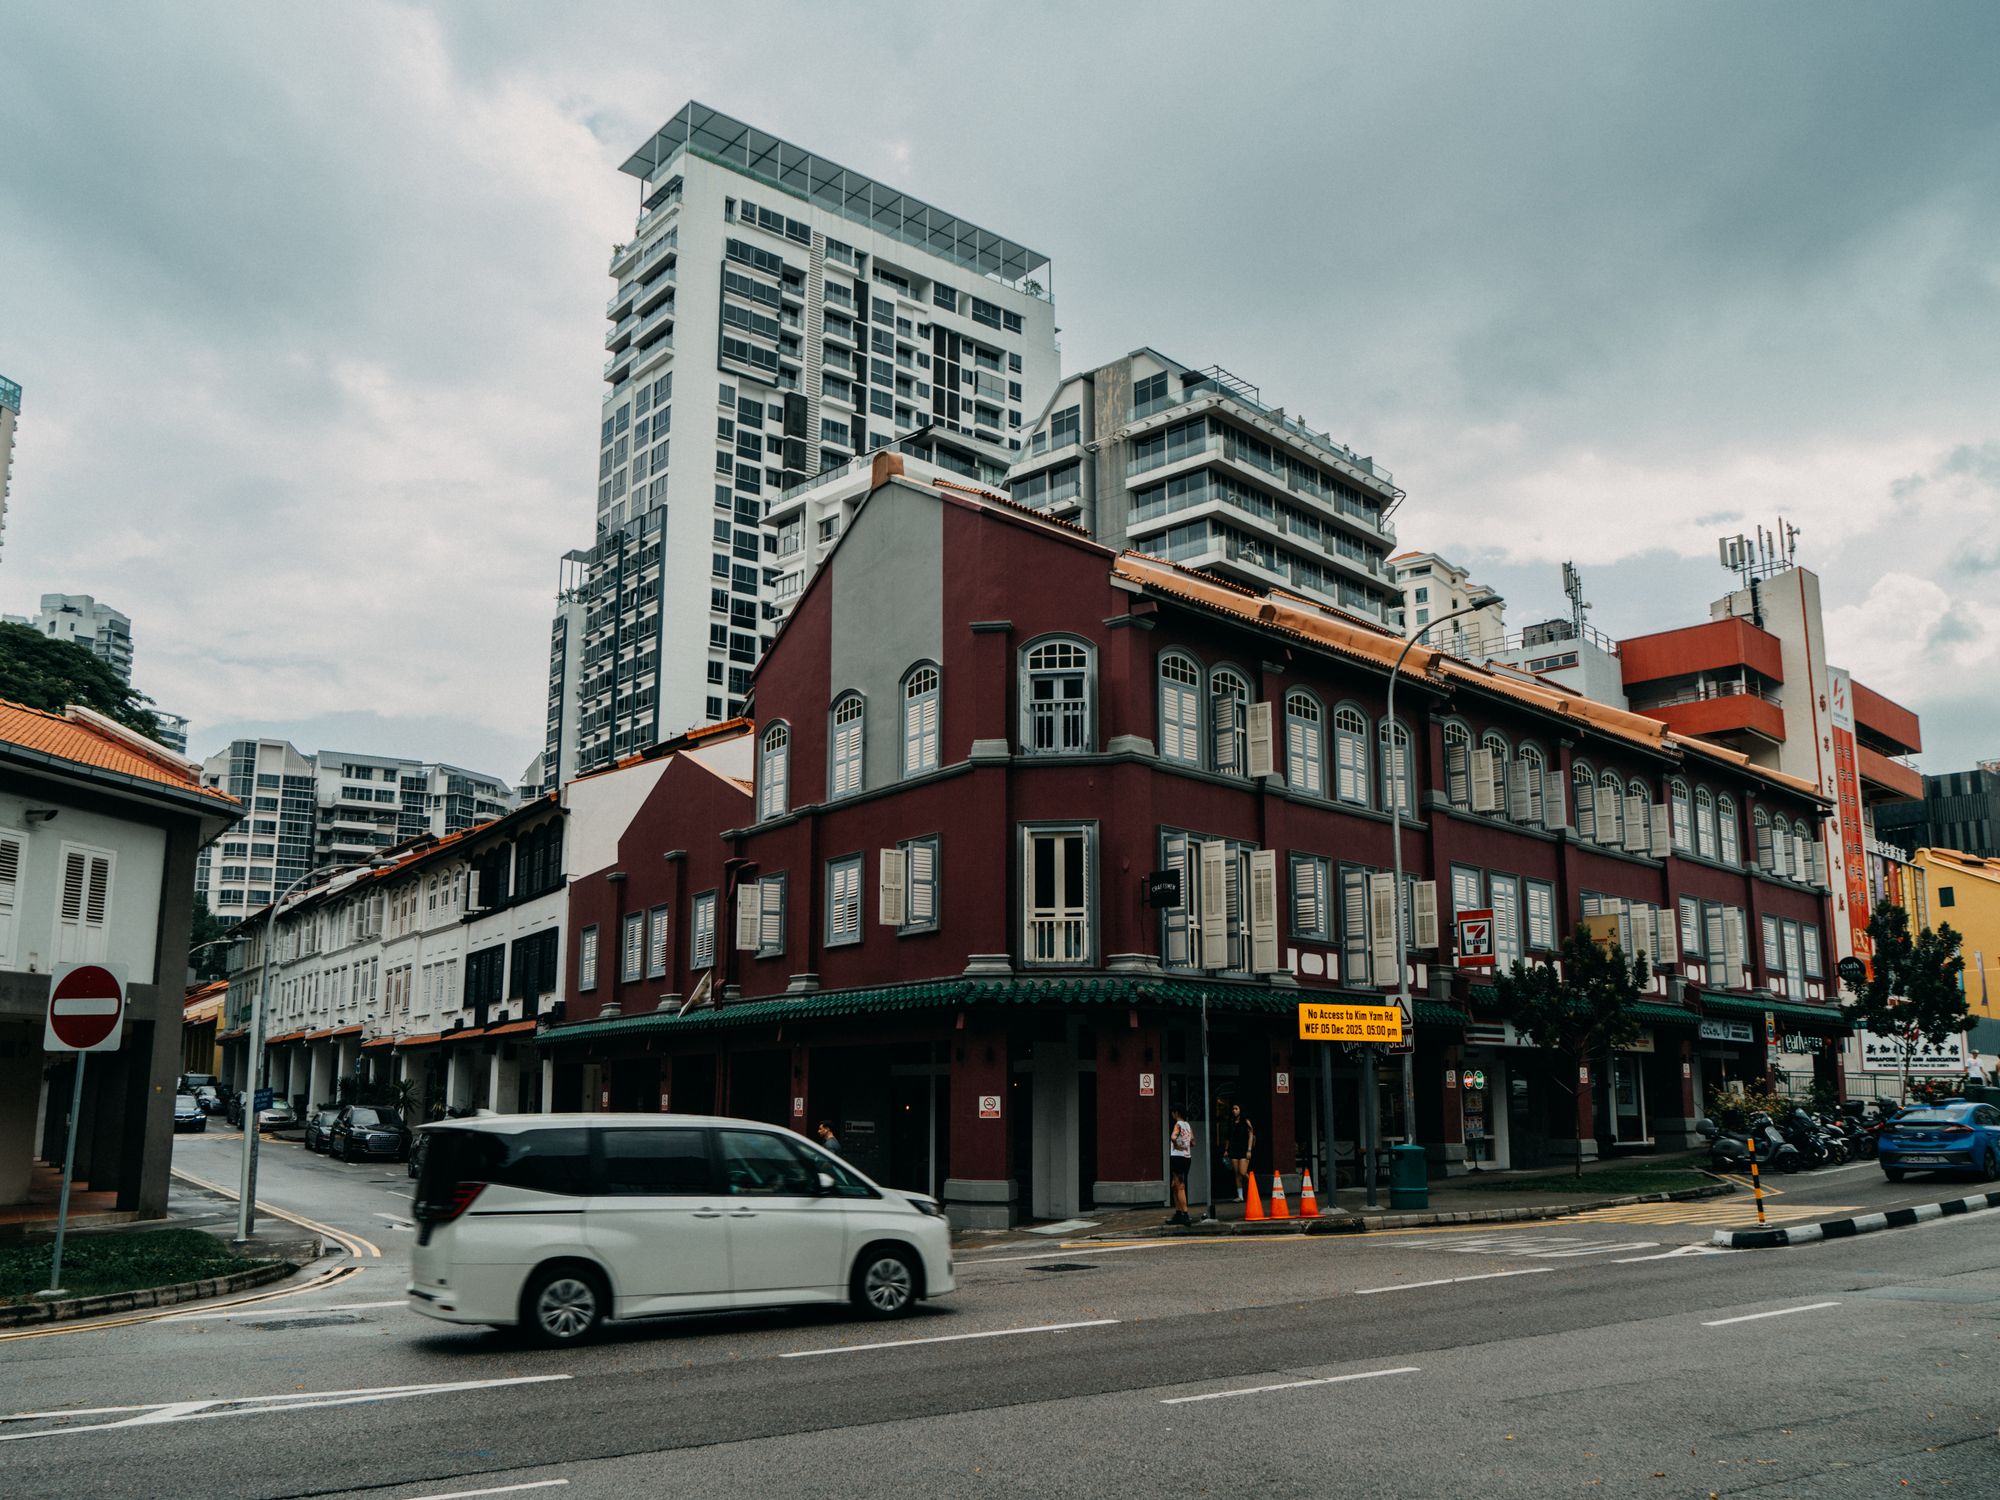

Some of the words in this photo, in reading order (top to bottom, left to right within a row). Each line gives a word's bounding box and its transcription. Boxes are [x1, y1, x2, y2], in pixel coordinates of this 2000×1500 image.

[1307, 1009, 1318, 1019] No
[1319, 1009, 1344, 1020] Access
[1346, 1010, 1354, 1020] to
[1354, 1010, 1367, 1021] Kim
[1368, 1011, 1383, 1021] Yam
[1384, 1012, 1393, 1021] Rd
[1304, 1023, 1319, 1033] WEF
[1321, 1024, 1330, 1034] 05
[1331, 1024, 1344, 1034] Dec
[1346, 1025, 1364, 1036] 2025,
[1366, 1025, 1386, 1036] 05:00
[1387, 1027, 1398, 1038] pm
[1367, 1233, 1661, 1258] AHEAD
